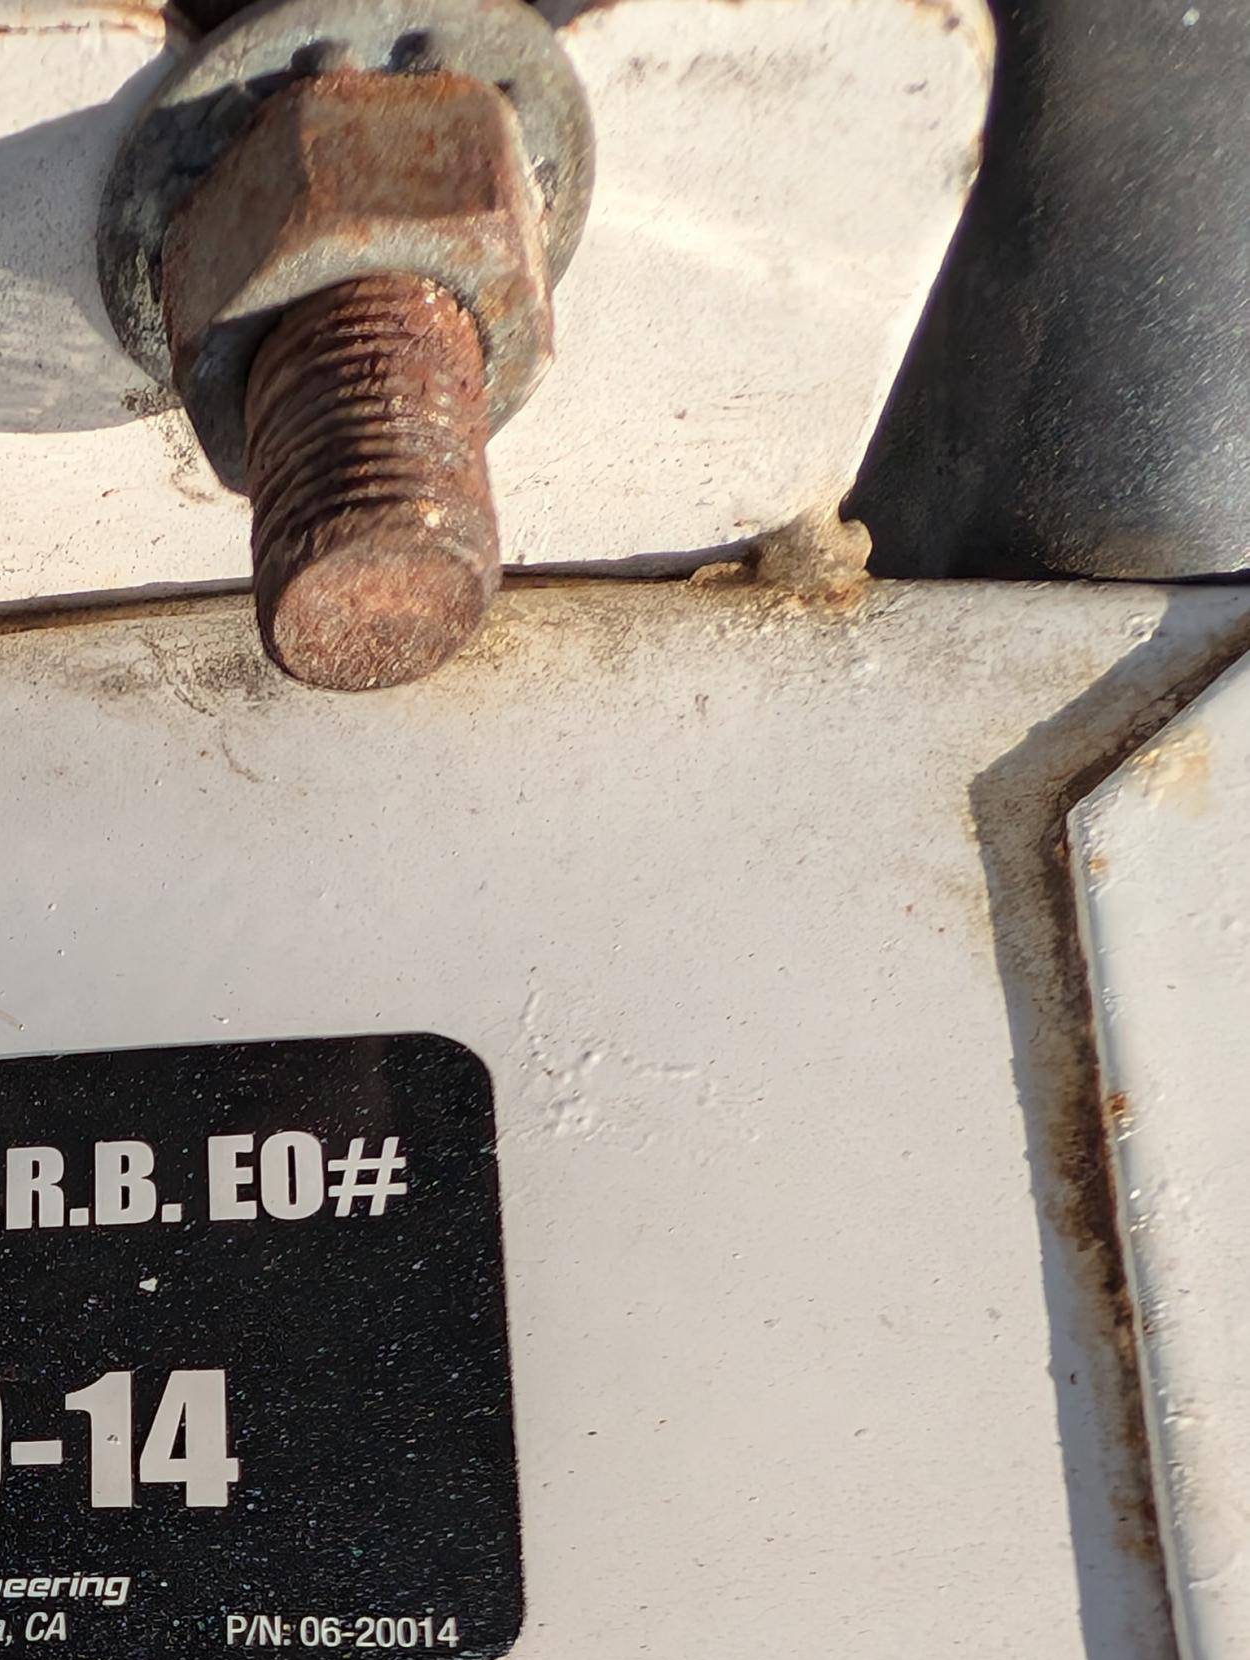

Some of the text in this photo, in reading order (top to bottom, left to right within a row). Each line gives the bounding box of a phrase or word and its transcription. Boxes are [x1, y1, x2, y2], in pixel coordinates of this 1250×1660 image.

[207, 1131, 408, 1221] EO#
[25, 1612, 67, 1642] CA
[226, 1615, 460, 1648] P/N: 06-20014
